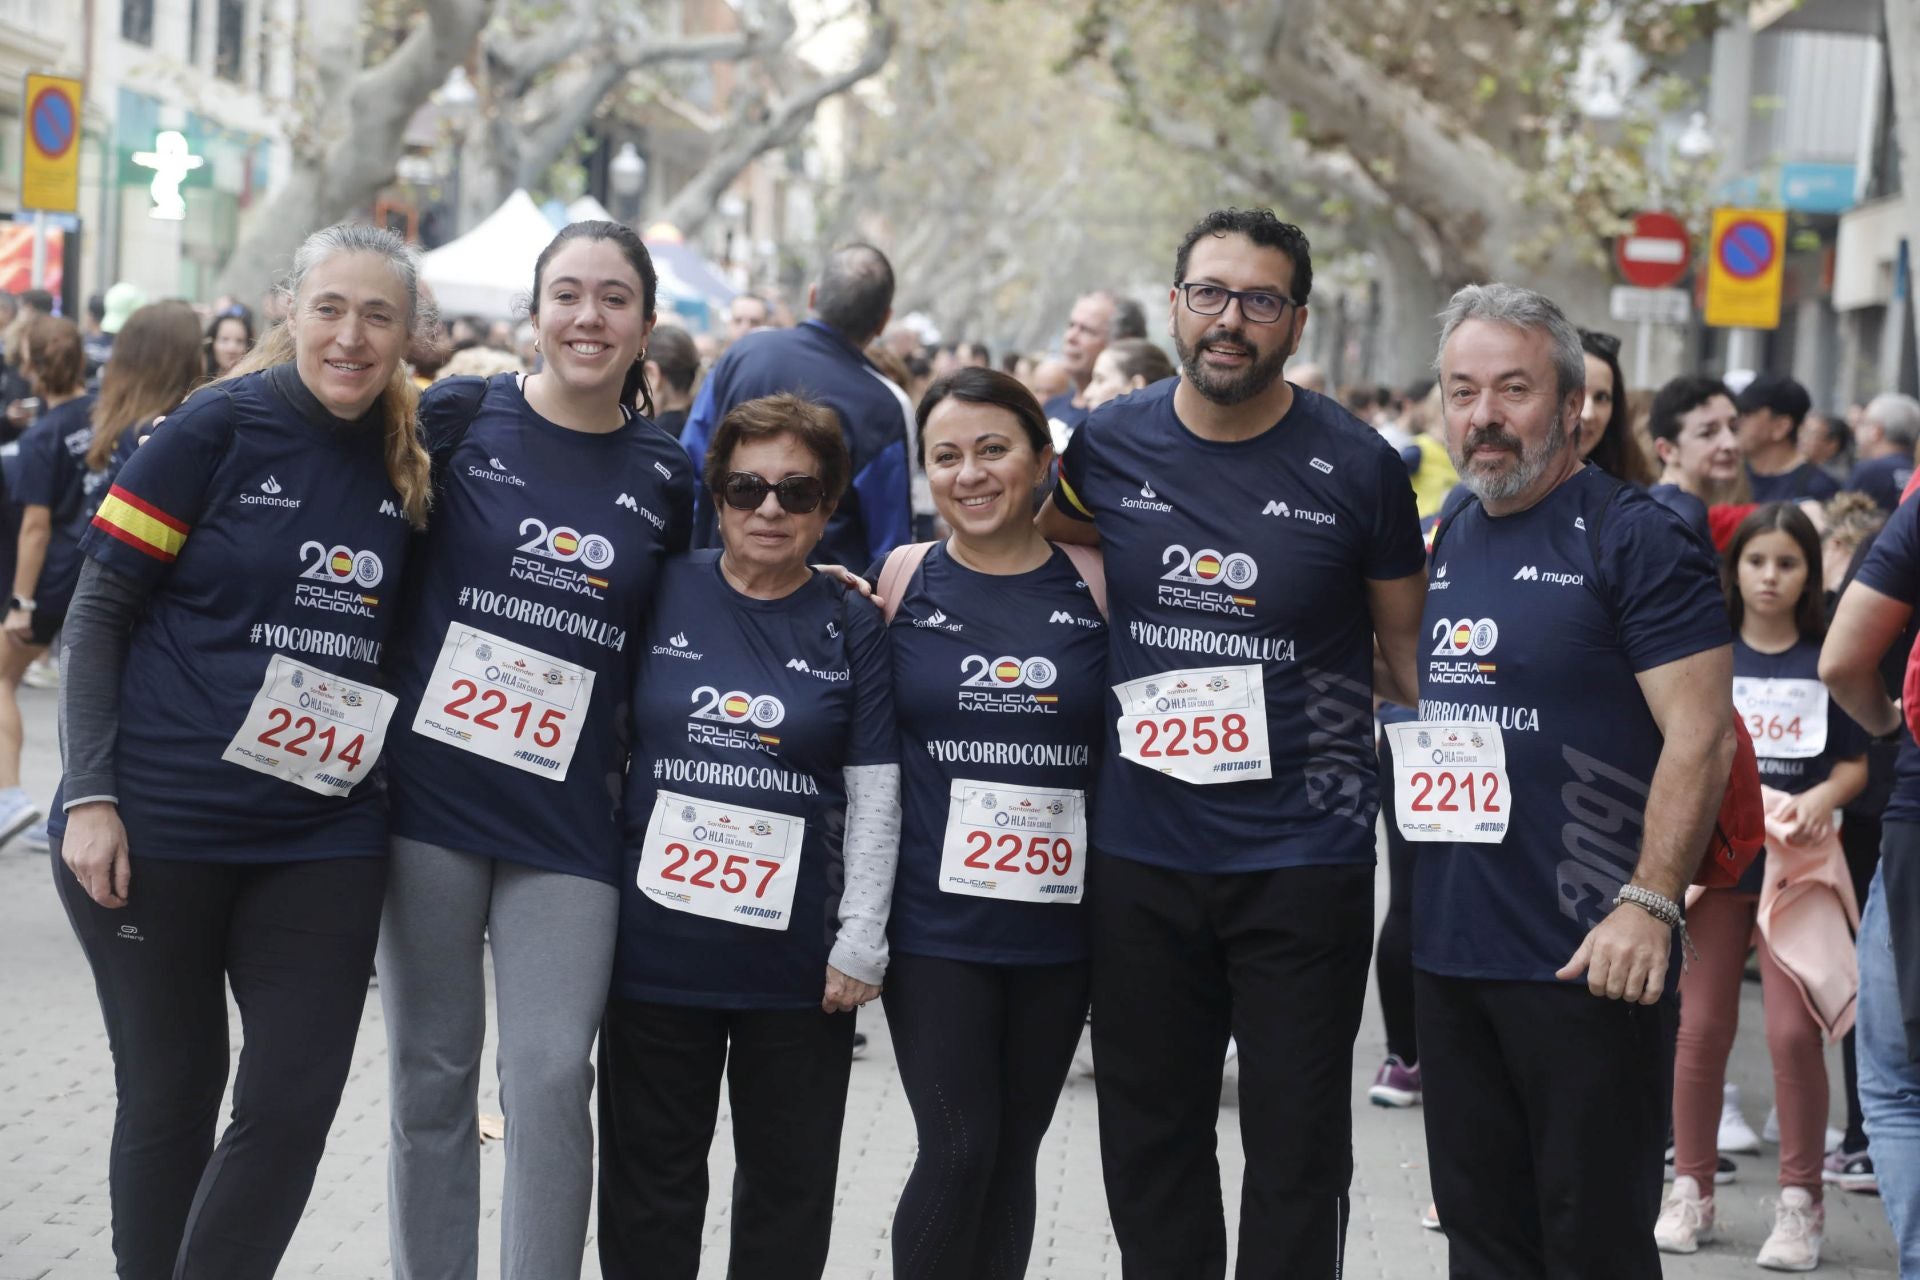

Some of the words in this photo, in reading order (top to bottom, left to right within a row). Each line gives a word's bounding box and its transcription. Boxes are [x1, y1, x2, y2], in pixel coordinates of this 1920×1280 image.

[468, 466, 526, 487] Santander
[240, 493, 301, 508] Santander
[1120, 497, 1173, 513] Santander
[1294, 508, 1336, 525] mupol
[515, 518, 615, 570] 200
[298, 541, 383, 588] 200
[1160, 544, 1258, 590] 200
[510, 567, 604, 600] NACIONAL
[1542, 572, 1584, 586] mupol
[294, 596, 375, 618] NACIONAL
[1158, 596, 1255, 618] NACIONAL
[458, 586, 626, 651] #YOCORROCONLUCA
[1130, 620, 1296, 662] #YOCORROCONLUCA
[1432, 618, 1498, 656] 200
[652, 646, 703, 660] Santander
[500, 672, 516, 686] HLA
[812, 668, 850, 682] mupol
[960, 654, 1057, 689] 200
[1429, 673, 1496, 684] NACIONAL
[444, 679, 566, 748] 2215
[688, 686, 786, 728] 200
[958, 702, 1058, 714] NACIONAL
[1172, 698, 1186, 709] HLA
[258, 708, 365, 772] 2214
[688, 734, 778, 756] NACIONAL
[1136, 714, 1249, 758] 2258
[514, 750, 560, 770] #RUTA091
[927, 740, 1088, 766] #YOCORROCONLUCA
[1445, 752, 1455, 762] HLA
[654, 758, 819, 796] #YOCORROCONLUCA
[1213, 760, 1262, 772] #RUTA091
[1411, 772, 1500, 812] 2212
[1011, 816, 1026, 827] HLA
[709, 830, 724, 844] HLA
[964, 830, 1072, 876] 2259
[660, 842, 780, 898] 2257
[1040, 884, 1078, 894] #RUTA091
[734, 905, 782, 920] #RUTA091
